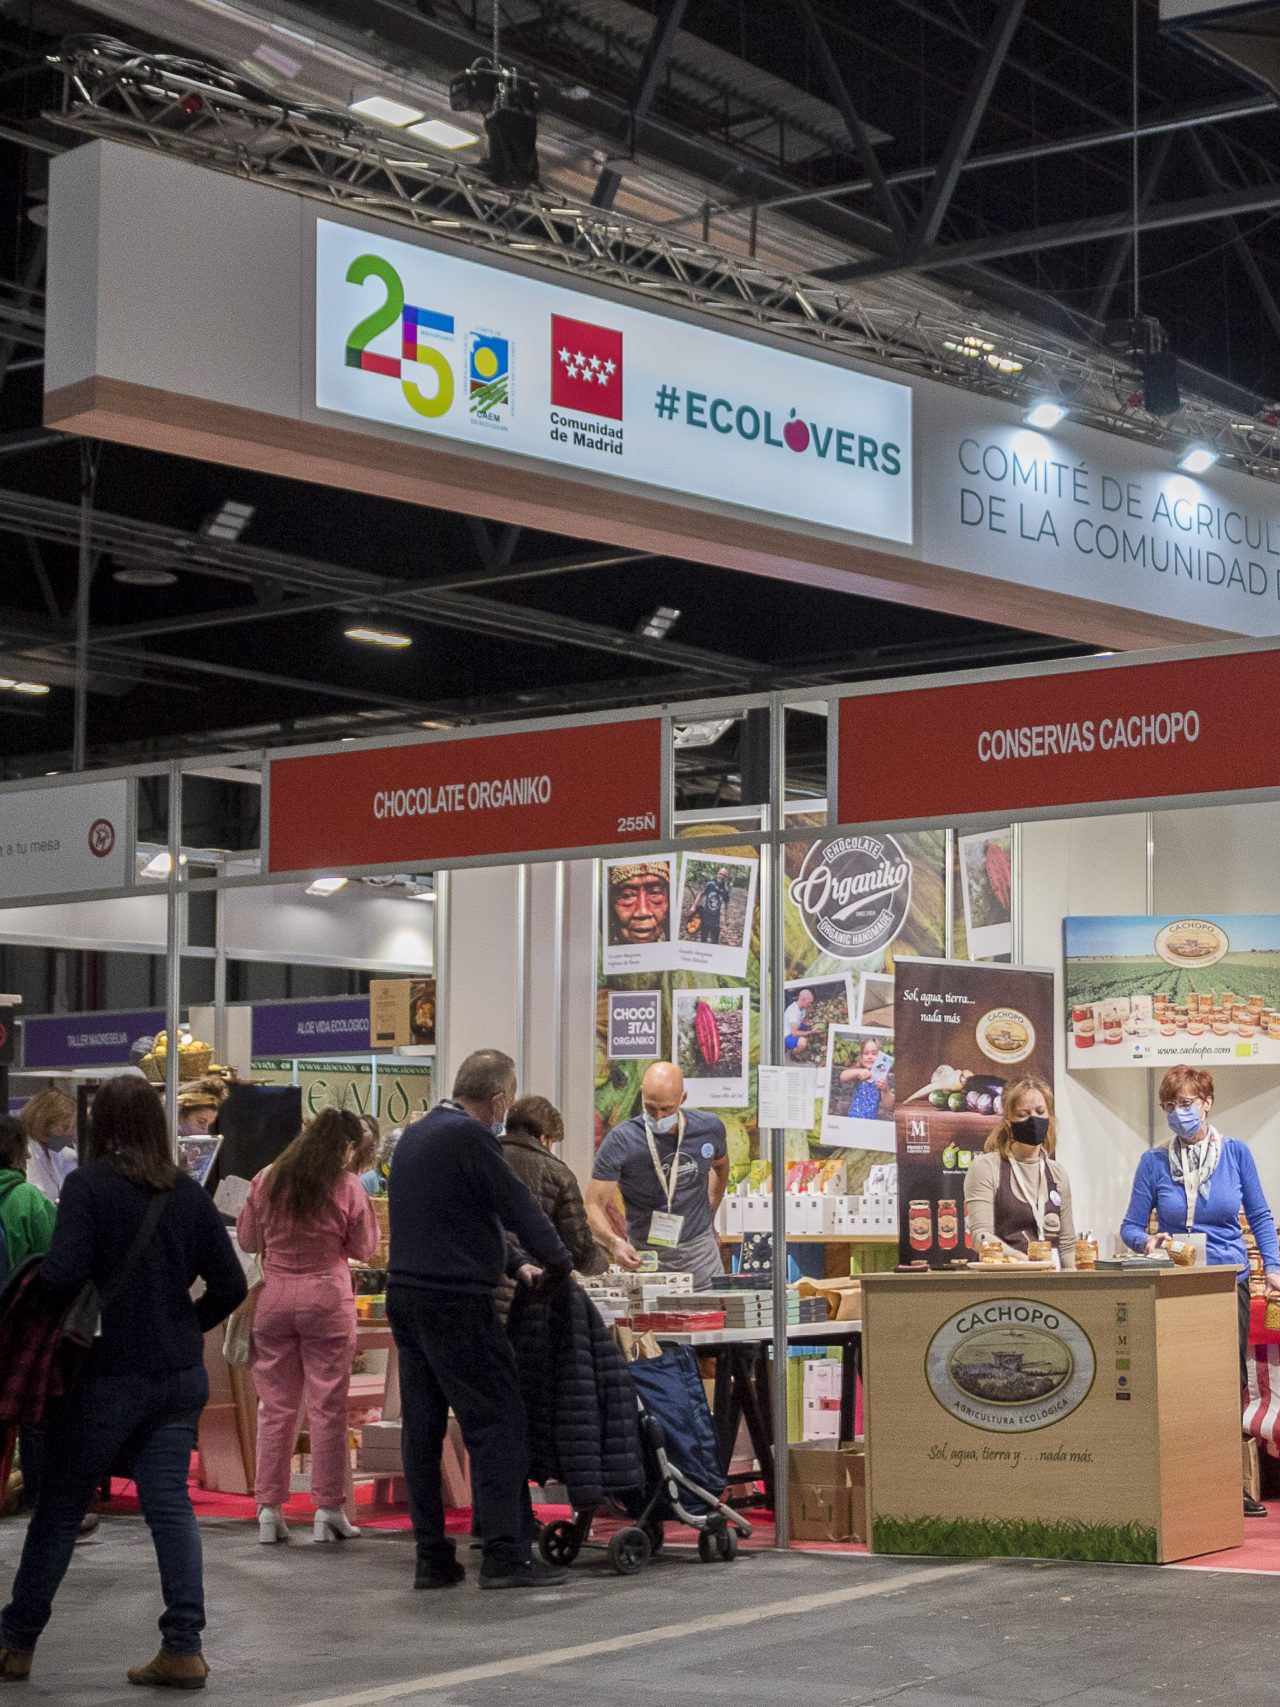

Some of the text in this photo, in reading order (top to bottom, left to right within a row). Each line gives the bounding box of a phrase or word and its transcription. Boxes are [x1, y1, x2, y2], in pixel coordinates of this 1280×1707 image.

[345, 253, 455, 418] 25
[550, 412, 624, 440] Comunidad
[550, 429, 624, 455] de Madrid
[958, 437, 1089, 505] COMITÉ
[1102, 475, 1143, 513] DE
[960, 487, 1007, 534] DE
[1019, 502, 1060, 547] LA
[1073, 518, 1268, 596] COMUNIDAD
[977, 709, 1200, 762] CONSERVAS CACHOPO
[373, 775, 552, 818] CHOCOLATE ORGANIKO
[617, 811, 656, 833] 255Ñ
[6, 839, 61, 856] a tu mesa
[826, 837, 881, 860] CHOCOLATE
[793, 860, 908, 914] Organiko
[820, 911, 891, 945] ORGANIC HANDMADE
[1168, 922, 1215, 934] CACHOPO
[903, 987, 919, 1001] Sol,
[920, 993, 944, 1007] agua,
[613, 1007, 656, 1021] CHOCO
[920, 1010, 960, 1024] nada más
[987, 1011, 1024, 1024] CACHOPO
[296, 1020, 315, 1035] ALOE
[316, 1019, 331, 1034] VIDA
[612, 1036, 656, 1046] ORGANIKO
[1157, 1041, 1231, 1059] www.cachopo.com
[910, 1120, 926, 1137] M
[956, 1306, 1060, 1334] CACHOPO
[1118, 1335, 1127, 1346] M
[953, 1398, 1069, 1426] AGRICULTURA ECOLÓGICA
[927, 1443, 948, 1461] Sol,
[950, 1449, 978, 1468] agua,
[982, 1446, 1010, 1461] tierra
[1010, 1450, 1021, 1469] y
